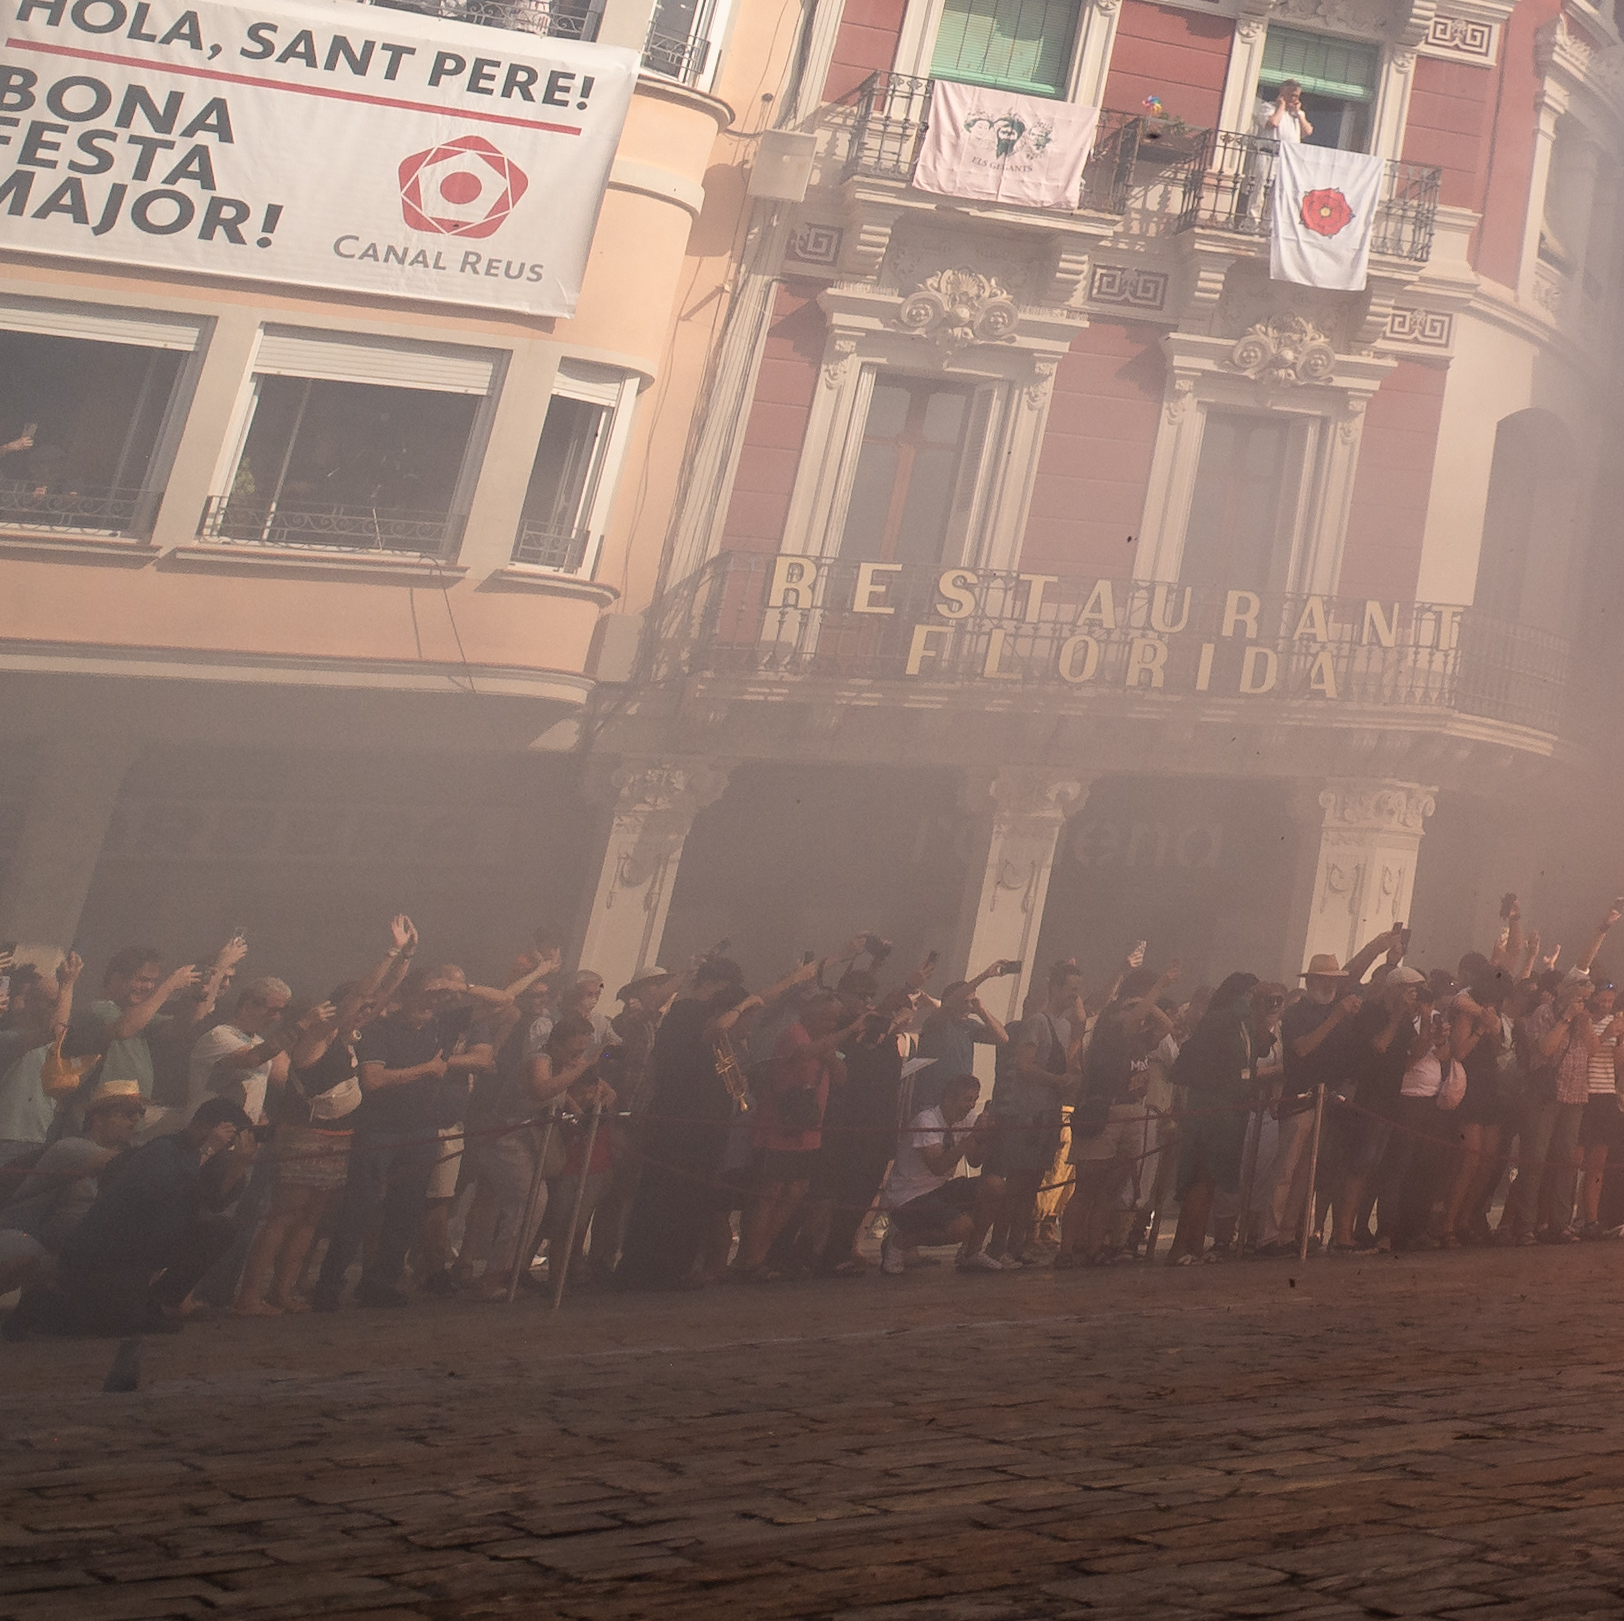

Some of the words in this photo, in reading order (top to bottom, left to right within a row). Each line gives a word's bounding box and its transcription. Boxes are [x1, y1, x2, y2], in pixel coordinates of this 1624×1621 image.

[0, 65, 235, 144] BONA
[240, 22, 416, 79] SANT
[427, 51, 595, 111] PERE!
[972, 156, 988, 167] ELS
[333, 234, 447, 271] CANAL
[459, 250, 544, 283] REUS
[767, 555, 1466, 652] RESTAURANT
[904, 625, 1339, 699] FLORIDA
